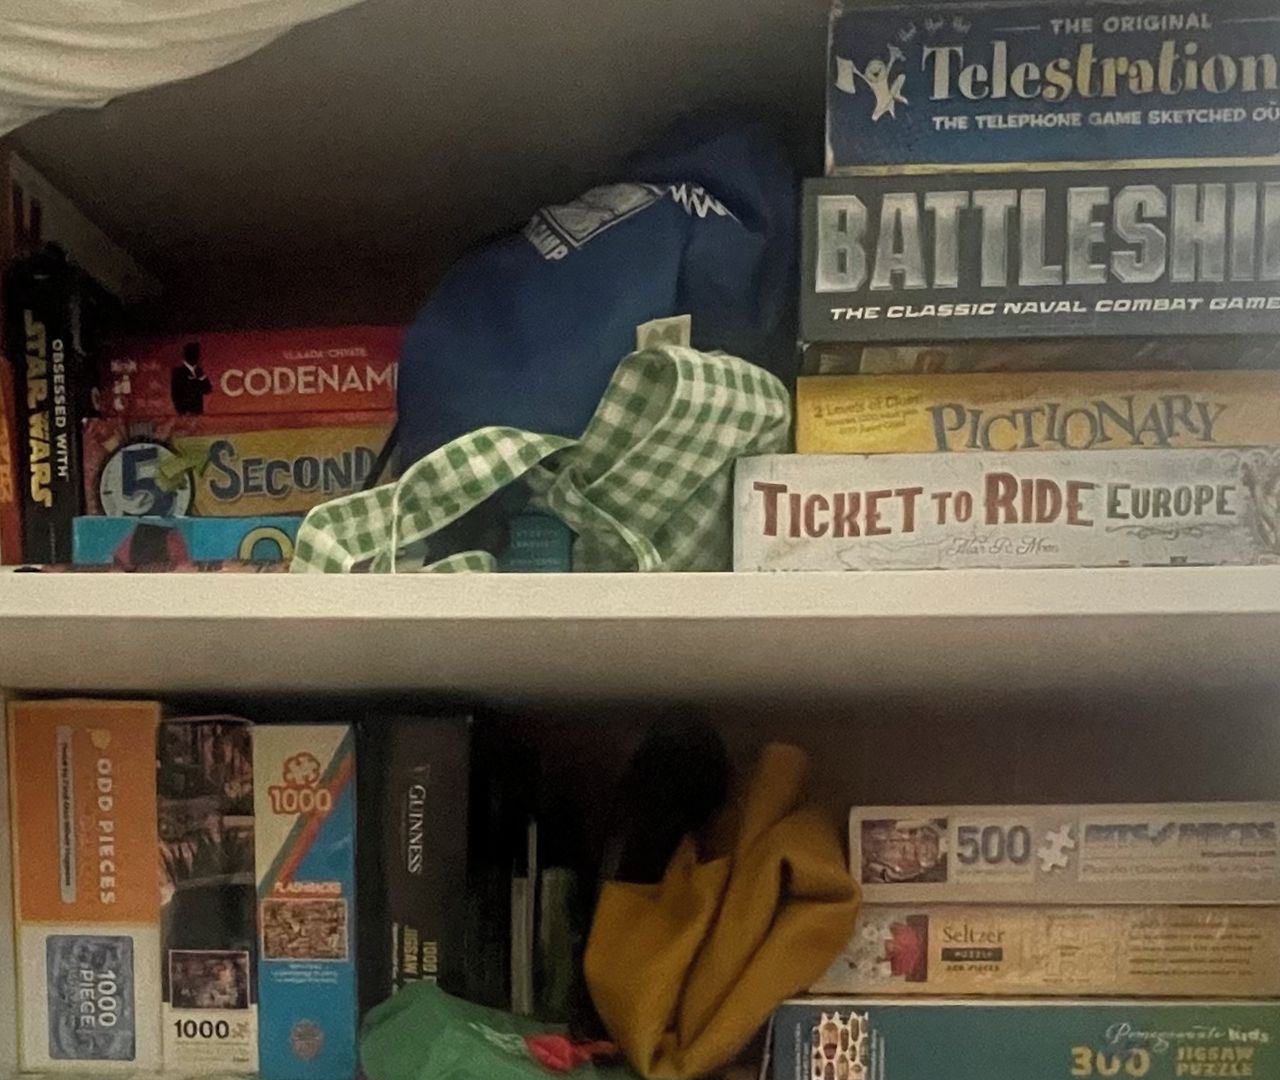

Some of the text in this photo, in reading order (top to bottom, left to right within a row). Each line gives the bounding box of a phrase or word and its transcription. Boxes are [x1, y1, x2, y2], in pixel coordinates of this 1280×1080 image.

[1050, 14, 1212, 35] THE ORIGINAL
[933, 115, 971, 130] THE
[976, 112, 1082, 129] TELEPHONE
[1088, 110, 1142, 126] GAME
[1148, 107, 1247, 125] SKETCHED
[830, 306, 881, 322] THE
[887, 303, 996, 320] CLASSIC
[1003, 300, 1087, 317] NAVAL
[1094, 297, 1203, 314] COMBAT
[24, 310, 52, 508] STAR WARS
[51, 339, 68, 481] OBSESSED WITH
[926, 394, 1228, 452] PICTIONARY
[122, 440, 377, 516] 5 SECOND
[753, 472, 1238, 539] TICKET TO RIDE EUROPE
[268, 785, 334, 815] 1000
[96, 757, 116, 905] ODD PIECES
[407, 783, 427, 875] GUINNESS
[957, 825, 1032, 866] 500
[402, 924, 420, 976] JIGSAW
[942, 923, 1006, 945] Seltzer
[422, 940, 439, 974] 1000
[79, 968, 96, 1028] PIECE
[97, 969, 117, 1028] 1000
[175, 1019, 230, 1040] 1000
[1070, 1045, 1153, 1079] 300
[1175, 1046, 1255, 1062] JIGSAW
[1175, 1062, 1254, 1078] PUZZLE
